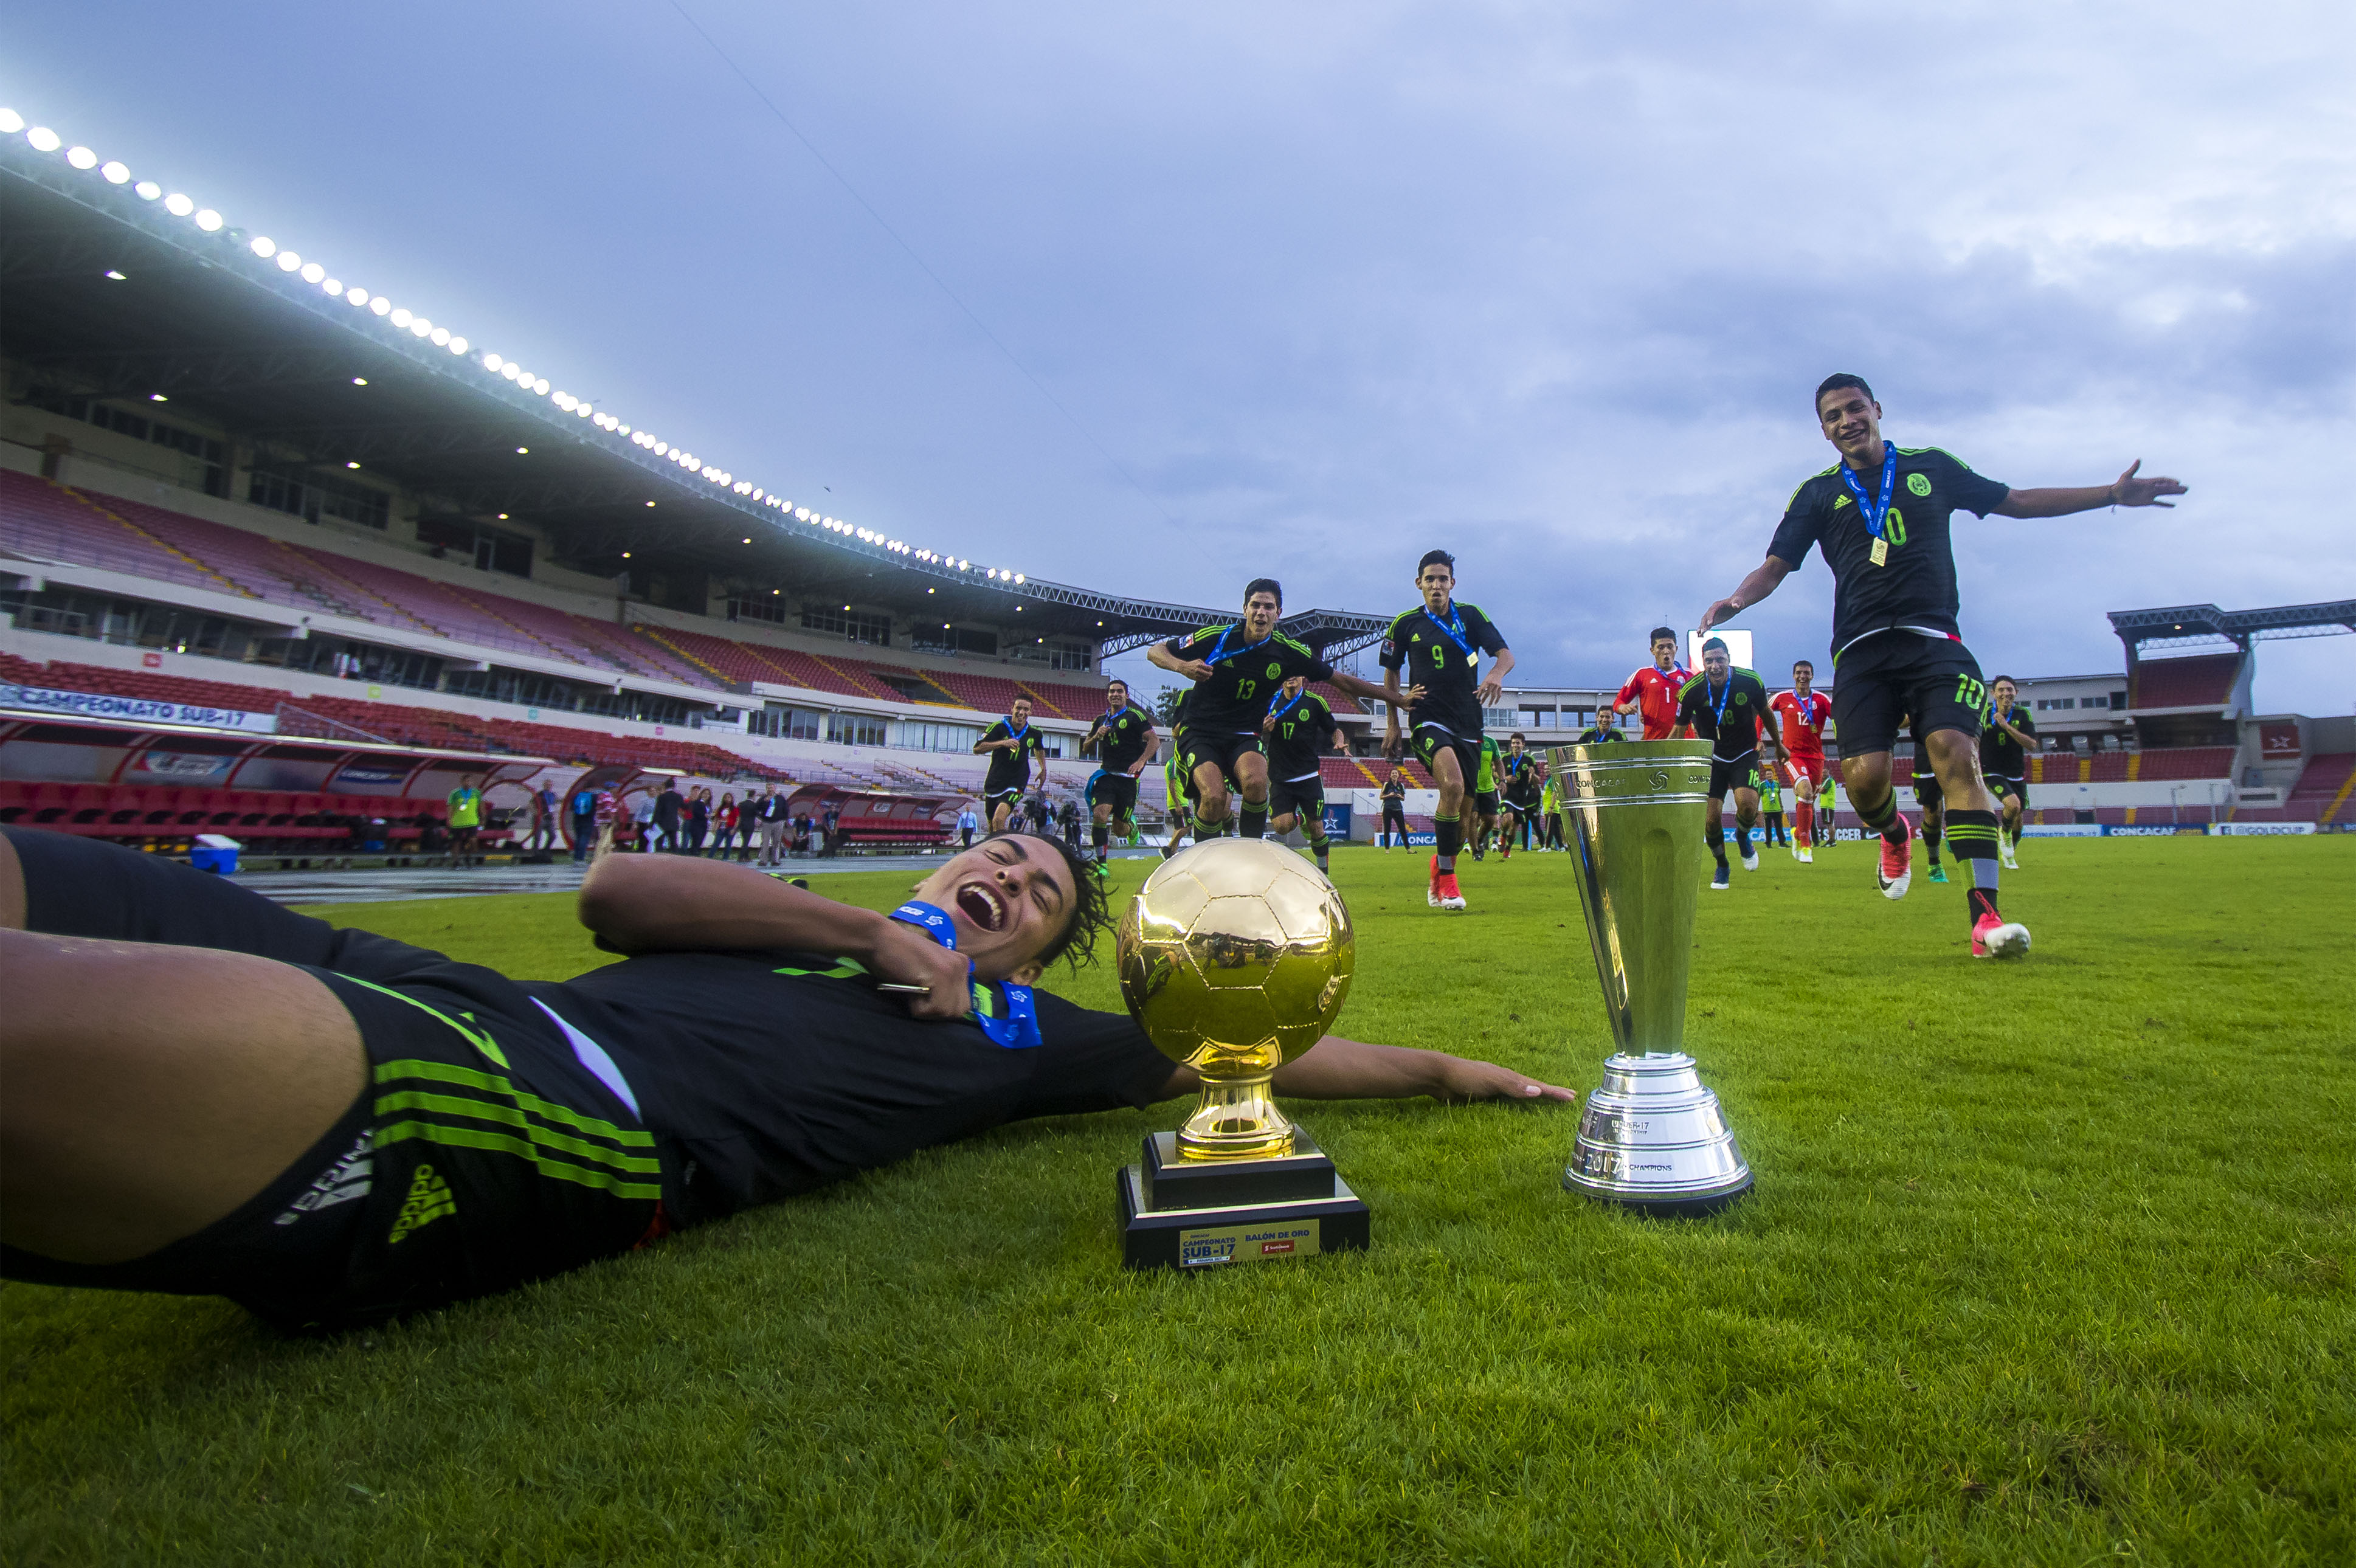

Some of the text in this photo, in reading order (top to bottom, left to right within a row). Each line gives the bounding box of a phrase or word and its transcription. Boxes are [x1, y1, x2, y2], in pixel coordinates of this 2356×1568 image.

[1432, 645, 1444, 669] 9
[1236, 679, 1256, 700] 13
[1665, 687, 1670, 703] 1
[1955, 673, 1985, 710] 10
[20, 689, 246, 727] CAMPEONATO SUB-17
[1797, 711, 1809, 725] 12
[1282, 722, 1295, 740] 17
[1748, 768, 1760, 787] 18
[1401, 836, 1437, 844] ONCA
[1823, 828, 1861, 841] SCCER
[1584, 1153, 1622, 1174] 2017
[389, 1164, 434, 1243] adidas
[1183, 1237, 1235, 1247] CAMPEONATO
[1245, 1231, 1276, 1242] BALÓN
[1183, 1243, 1235, 1258] SUB-17
